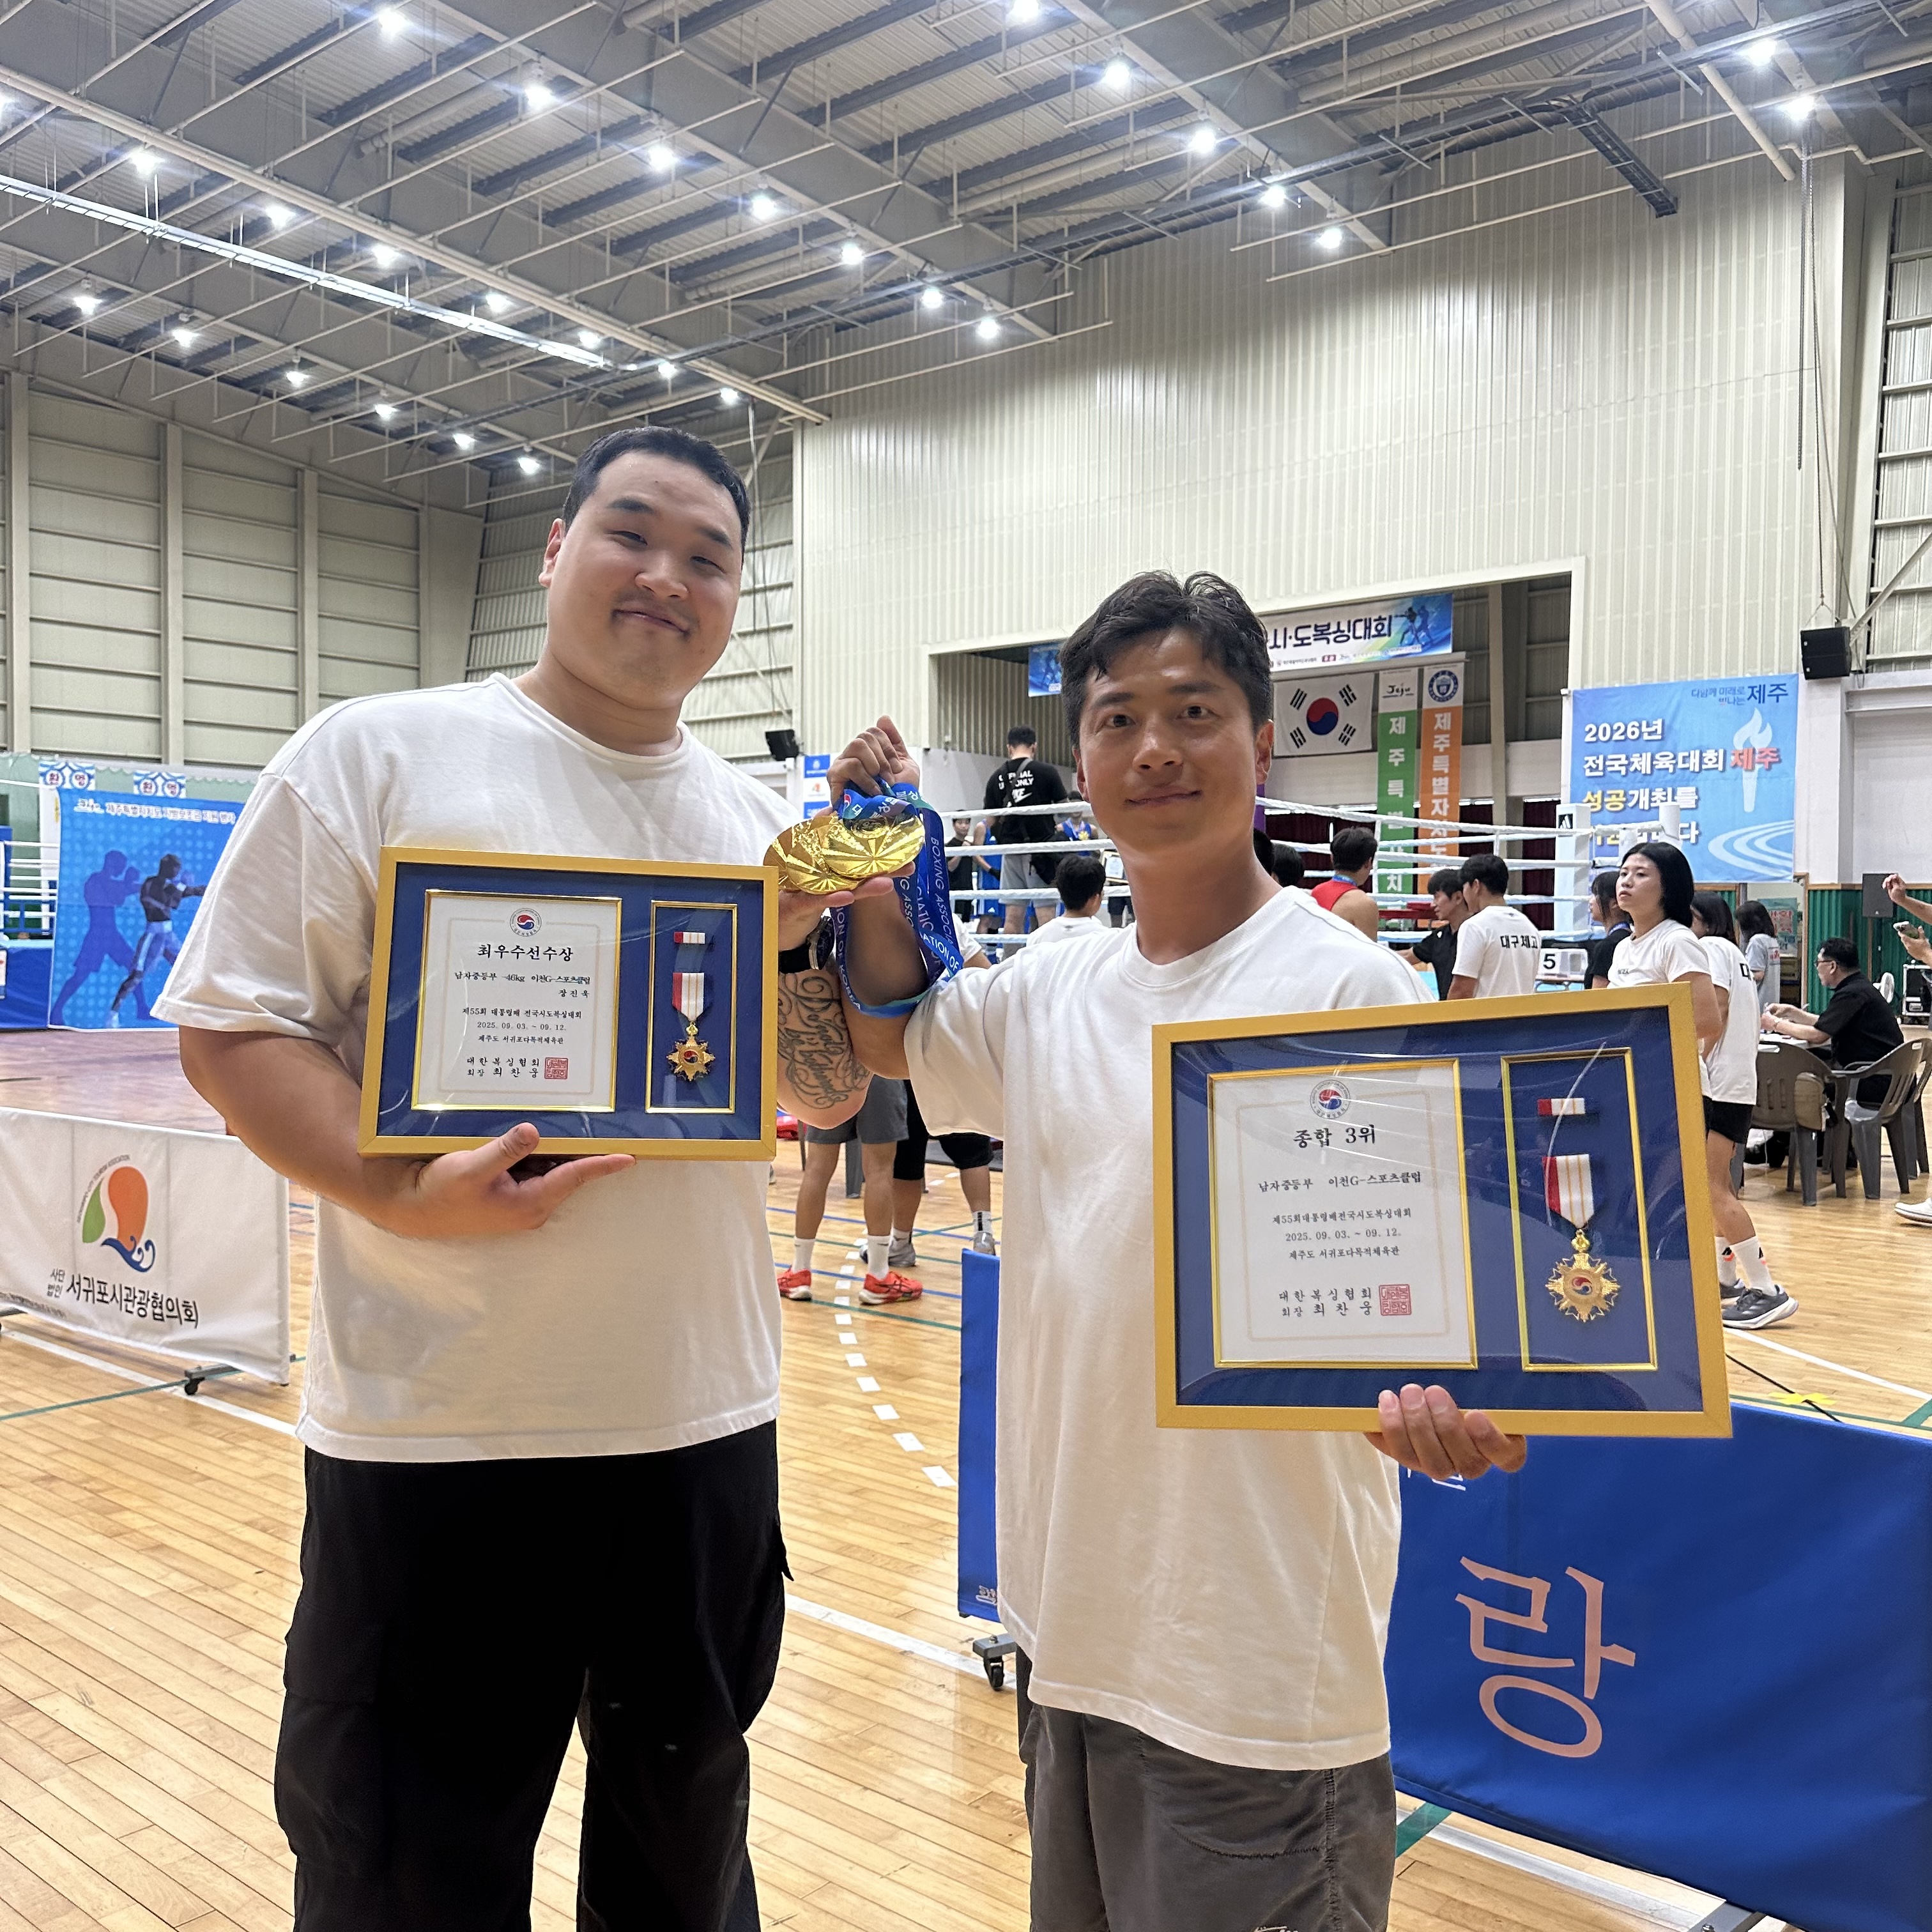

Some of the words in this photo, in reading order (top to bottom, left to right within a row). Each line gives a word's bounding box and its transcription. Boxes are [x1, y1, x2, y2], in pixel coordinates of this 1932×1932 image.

[1747, 683, 1789, 704] 제주
[1584, 717, 1664, 742] 2026년
[1583, 748, 1725, 777] 전국체육대회
[1730, 747, 1782, 770] 제주
[931, 836, 945, 891] BOXING
[477, 944, 574, 962] 최우수선수상
[1543, 953, 1556, 970] 5
[949, 956, 960, 971] OF
[454, 971, 498, 981] 남자중등부
[839, 964, 861, 1010] KOREA
[462, 1007, 487, 1016] 제55회
[1293, 1127, 1333, 1149] 종합
[1345, 1124, 1376, 1144] 3위
[1258, 1178, 1314, 1193] 남자중등부
[1285, 1232, 1312, 1242] 2025.
[1315, 1231, 1331, 1241] 09.
[1335, 1230, 1350, 1239] 03.
[1365, 1229, 1381, 1238] 09.
[1386, 1228, 1402, 1238] 12.
[1289, 1248, 1315, 1261] 제주도
[1319, 1245, 1400, 1259] 서귀포다목적체육관
[50, 1268, 65, 1283] 사단
[47, 1284, 63, 1298] 법인
[66, 1274, 199, 1329] 서귀포시관광협의회
